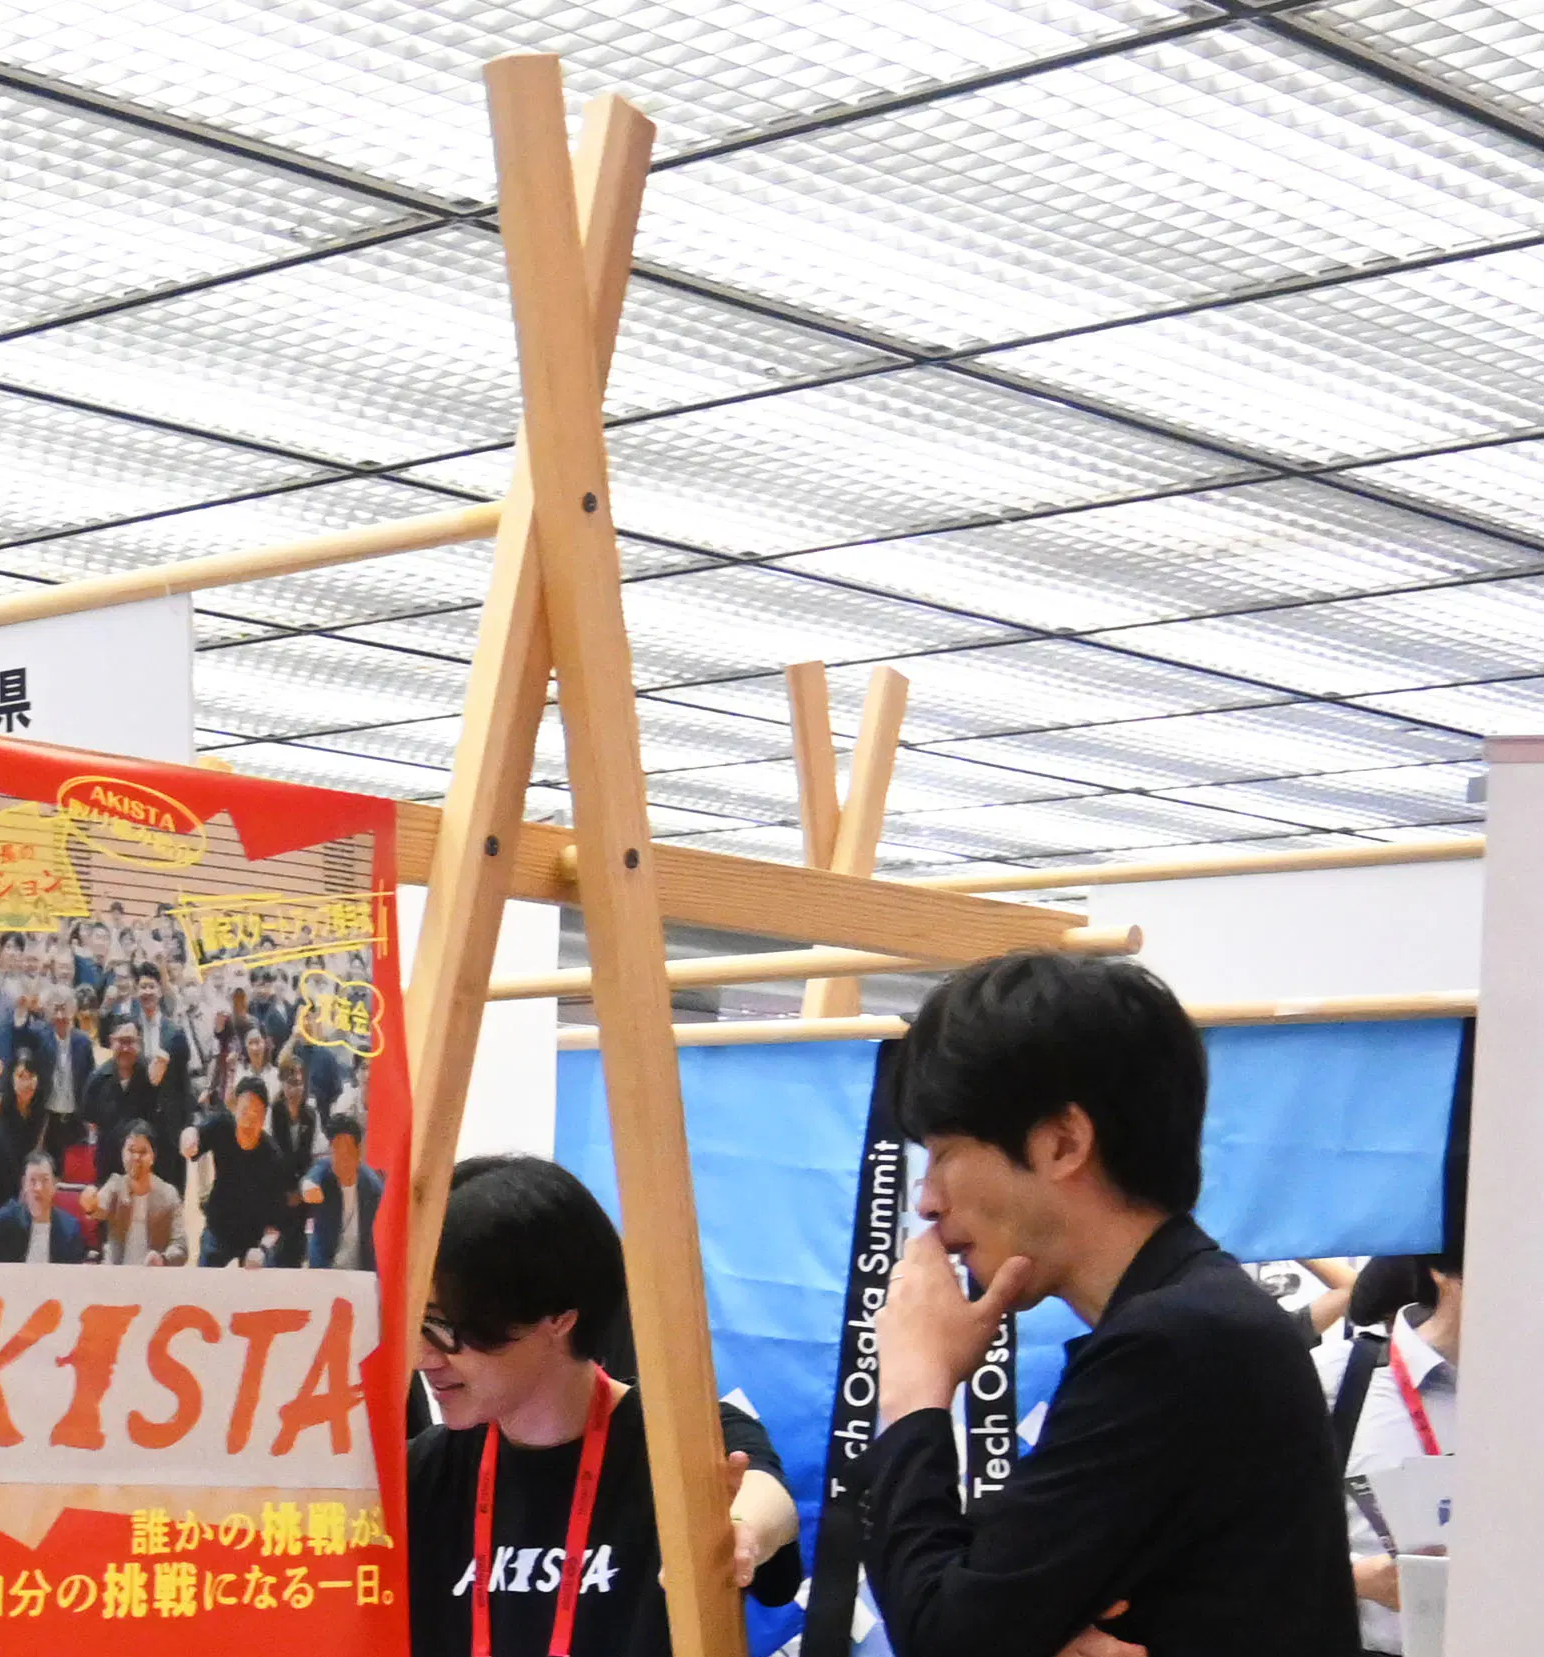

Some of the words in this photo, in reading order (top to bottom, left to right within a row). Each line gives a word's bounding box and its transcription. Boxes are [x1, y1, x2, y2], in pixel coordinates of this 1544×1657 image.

[90, 785, 176, 833] AKISTA
[830, 1418, 871, 1500] Tch
[858, 1139, 900, 1276] Summit
[971, 1414, 1012, 1500] Tech
[130, 1501, 394, 1557] 誰かの挑戦が、
[451, 1543, 622, 1597] AKISA
